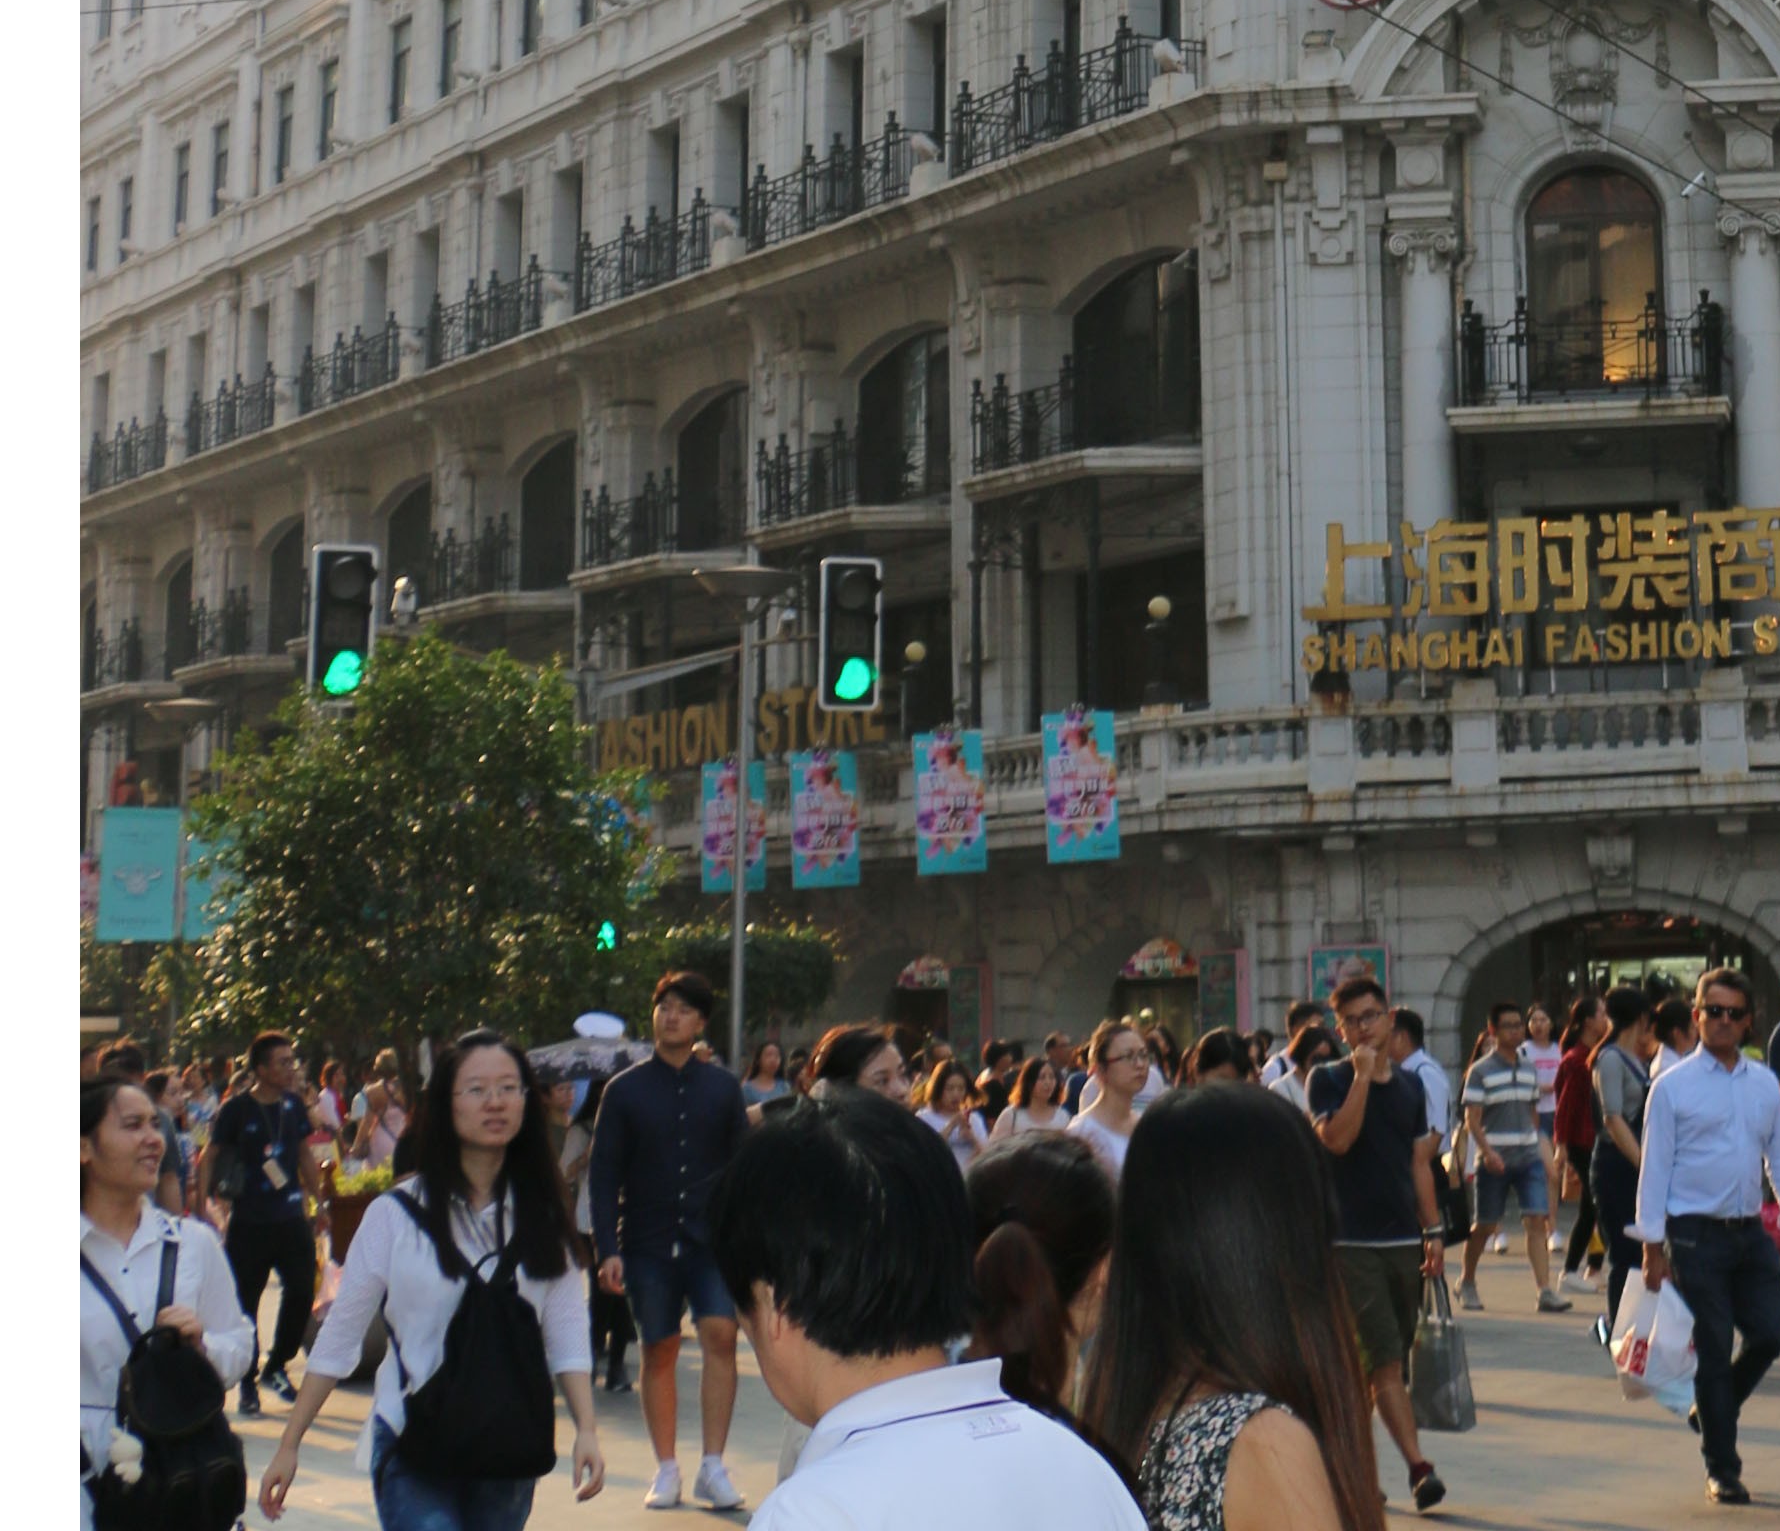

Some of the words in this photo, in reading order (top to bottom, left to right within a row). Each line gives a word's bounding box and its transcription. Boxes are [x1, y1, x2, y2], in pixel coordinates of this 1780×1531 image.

[1301, 626, 1523, 674] SHANGHAI
[1544, 619, 1732, 663] FASHION
[599, 702, 728, 775] ASHION
